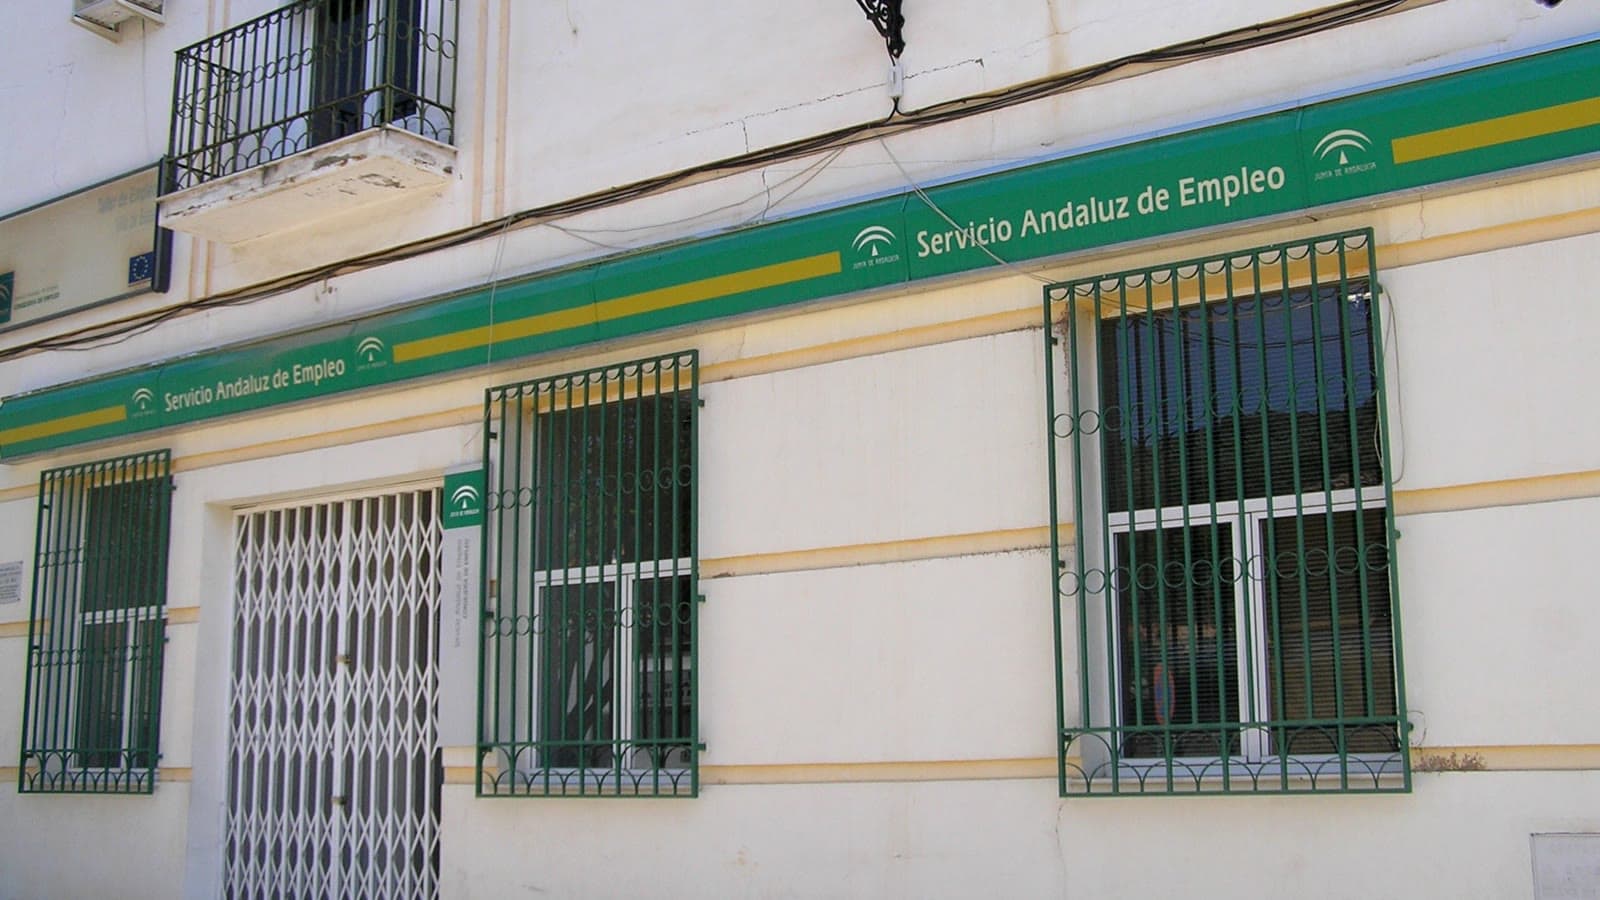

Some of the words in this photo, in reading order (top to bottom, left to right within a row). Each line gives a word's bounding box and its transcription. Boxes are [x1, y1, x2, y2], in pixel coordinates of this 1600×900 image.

[917, 217, 1012, 257] Servicio
[1020, 197, 1130, 238] Andaluz
[1137, 185, 1170, 215] de
[1179, 165, 1286, 207] Empleo
[164, 386, 212, 412] Servicio
[215, 375, 270, 401] Andaluz
[272, 370, 289, 388] de
[293, 358, 345, 386] Empleo
